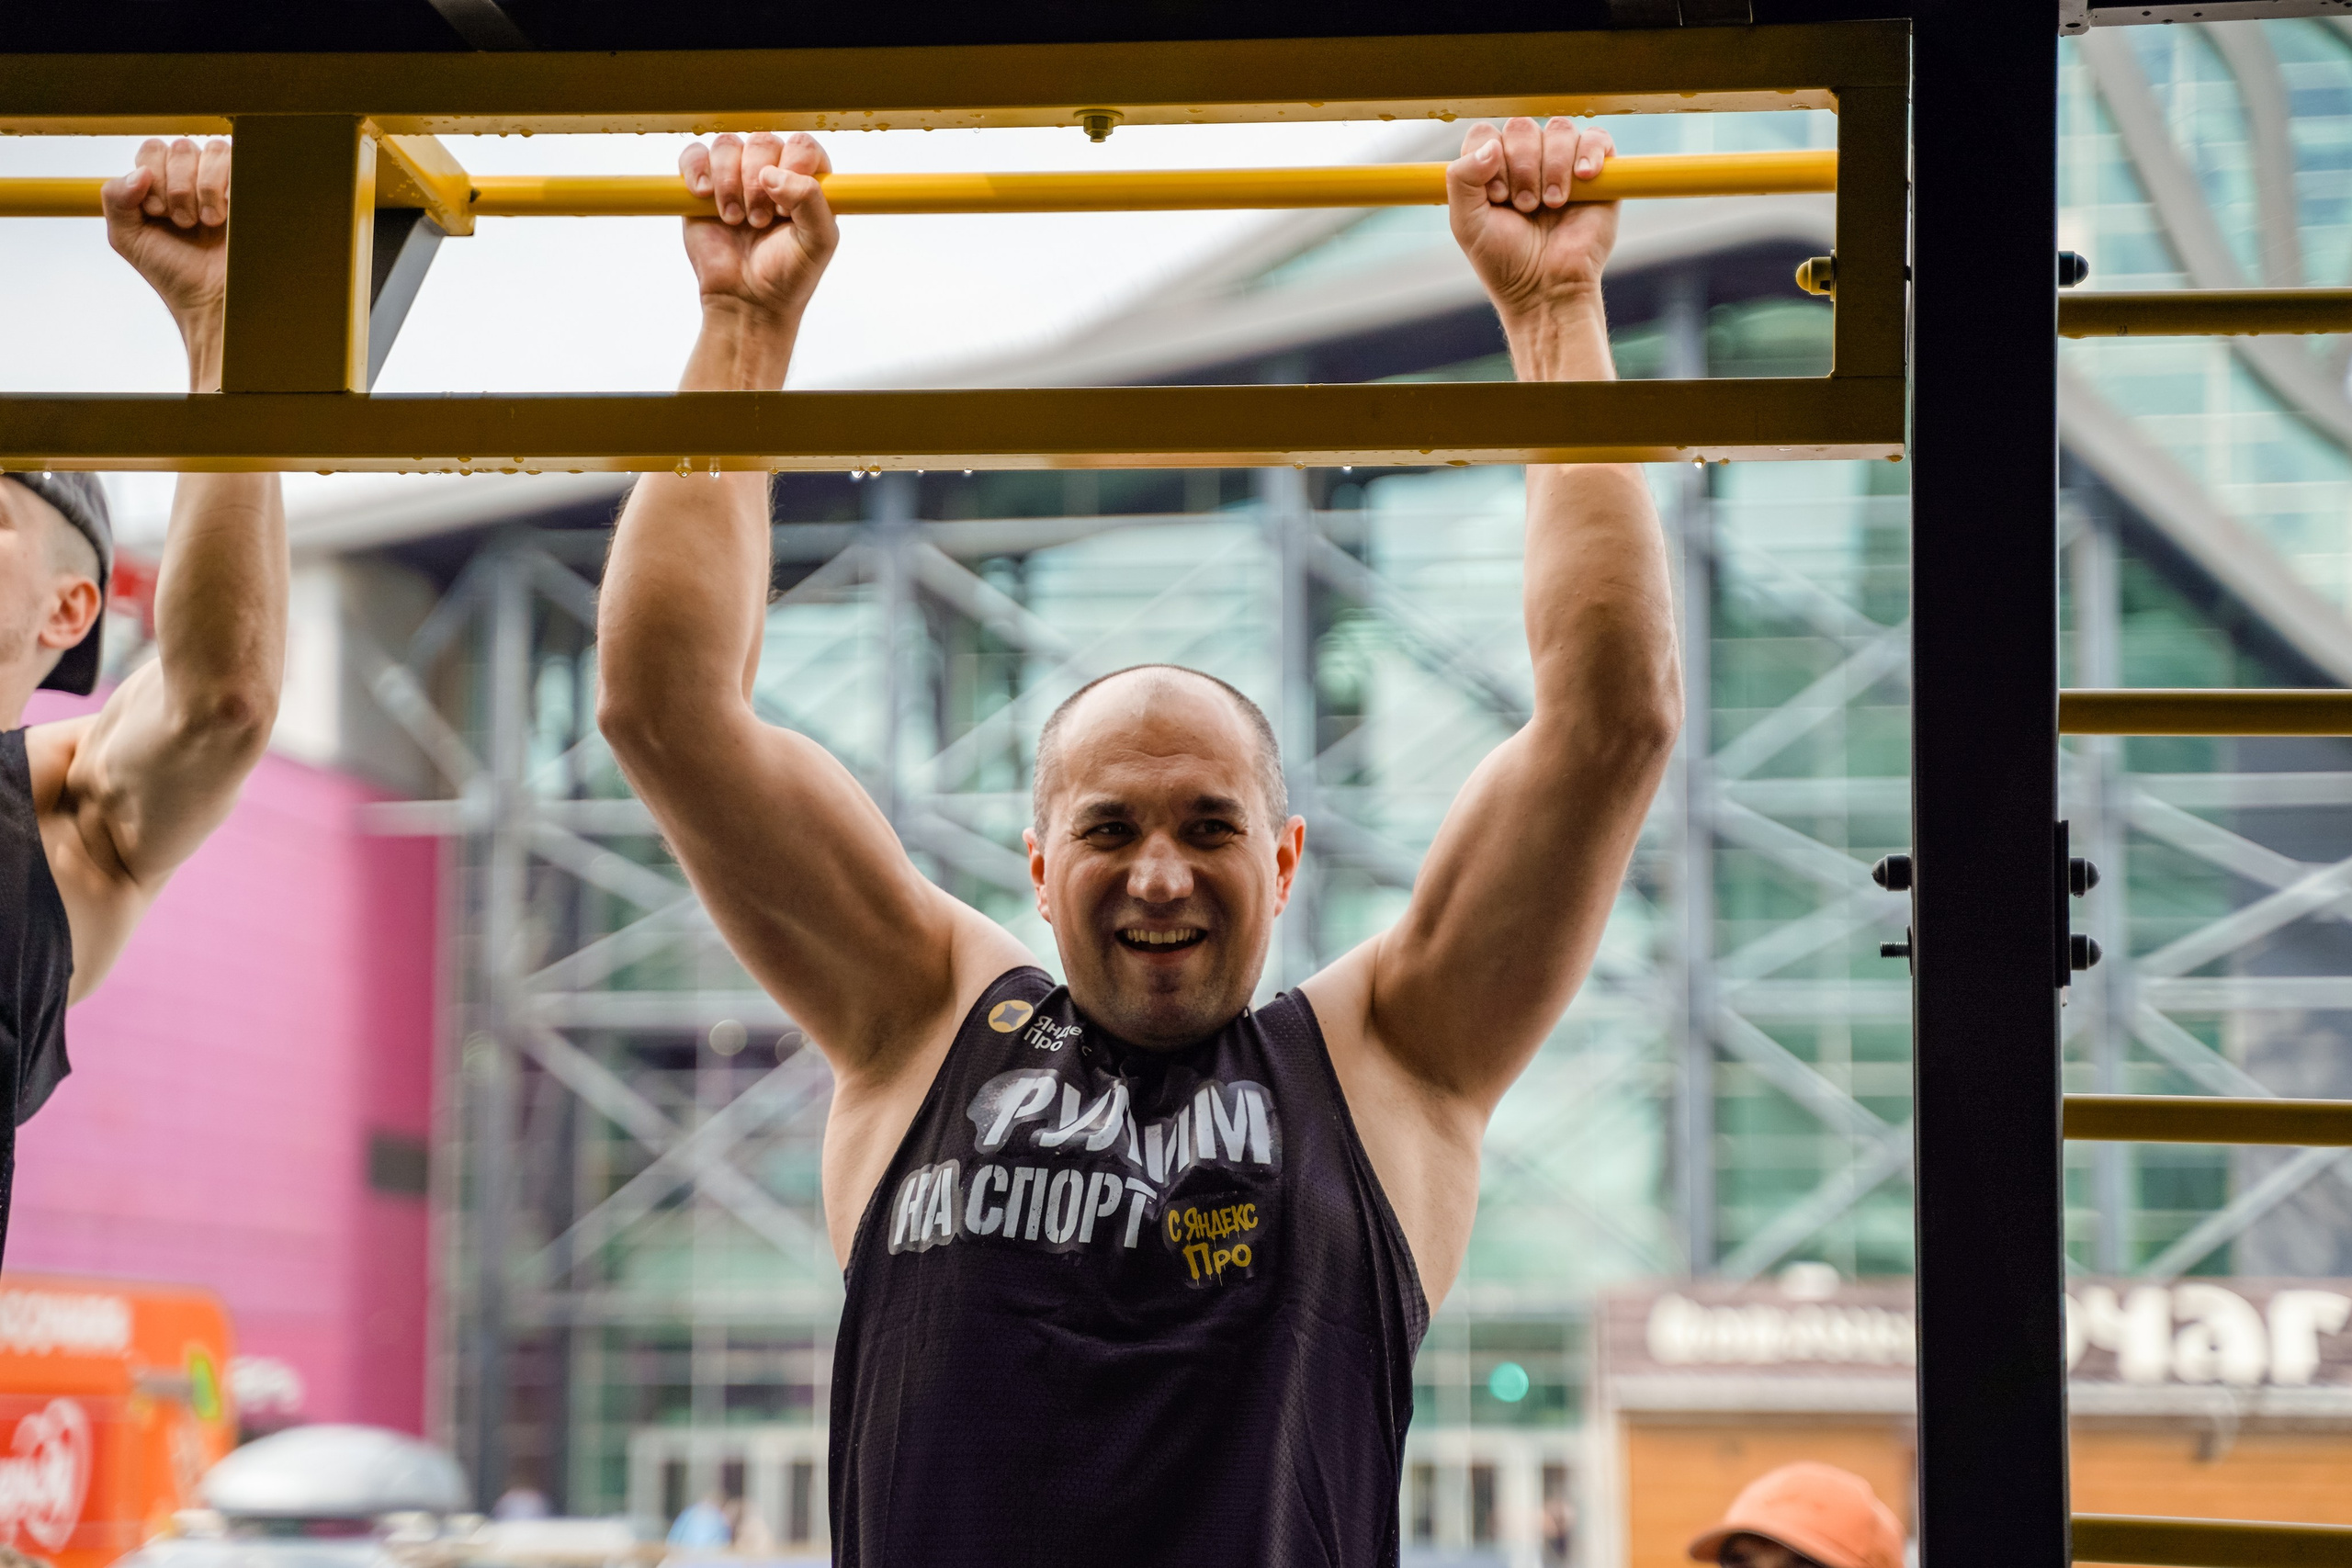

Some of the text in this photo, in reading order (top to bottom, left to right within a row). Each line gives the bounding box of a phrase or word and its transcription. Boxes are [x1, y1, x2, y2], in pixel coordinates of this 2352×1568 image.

[1023, 1028, 1064, 1052] Про
[1034, 1015, 1091, 1056] Яндес
[983, 1076, 1272, 1184] РУЛИМ
[893, 1164, 1158, 1248] НА СПОРТ
[2065, 1283, 2351, 1384] чаг
